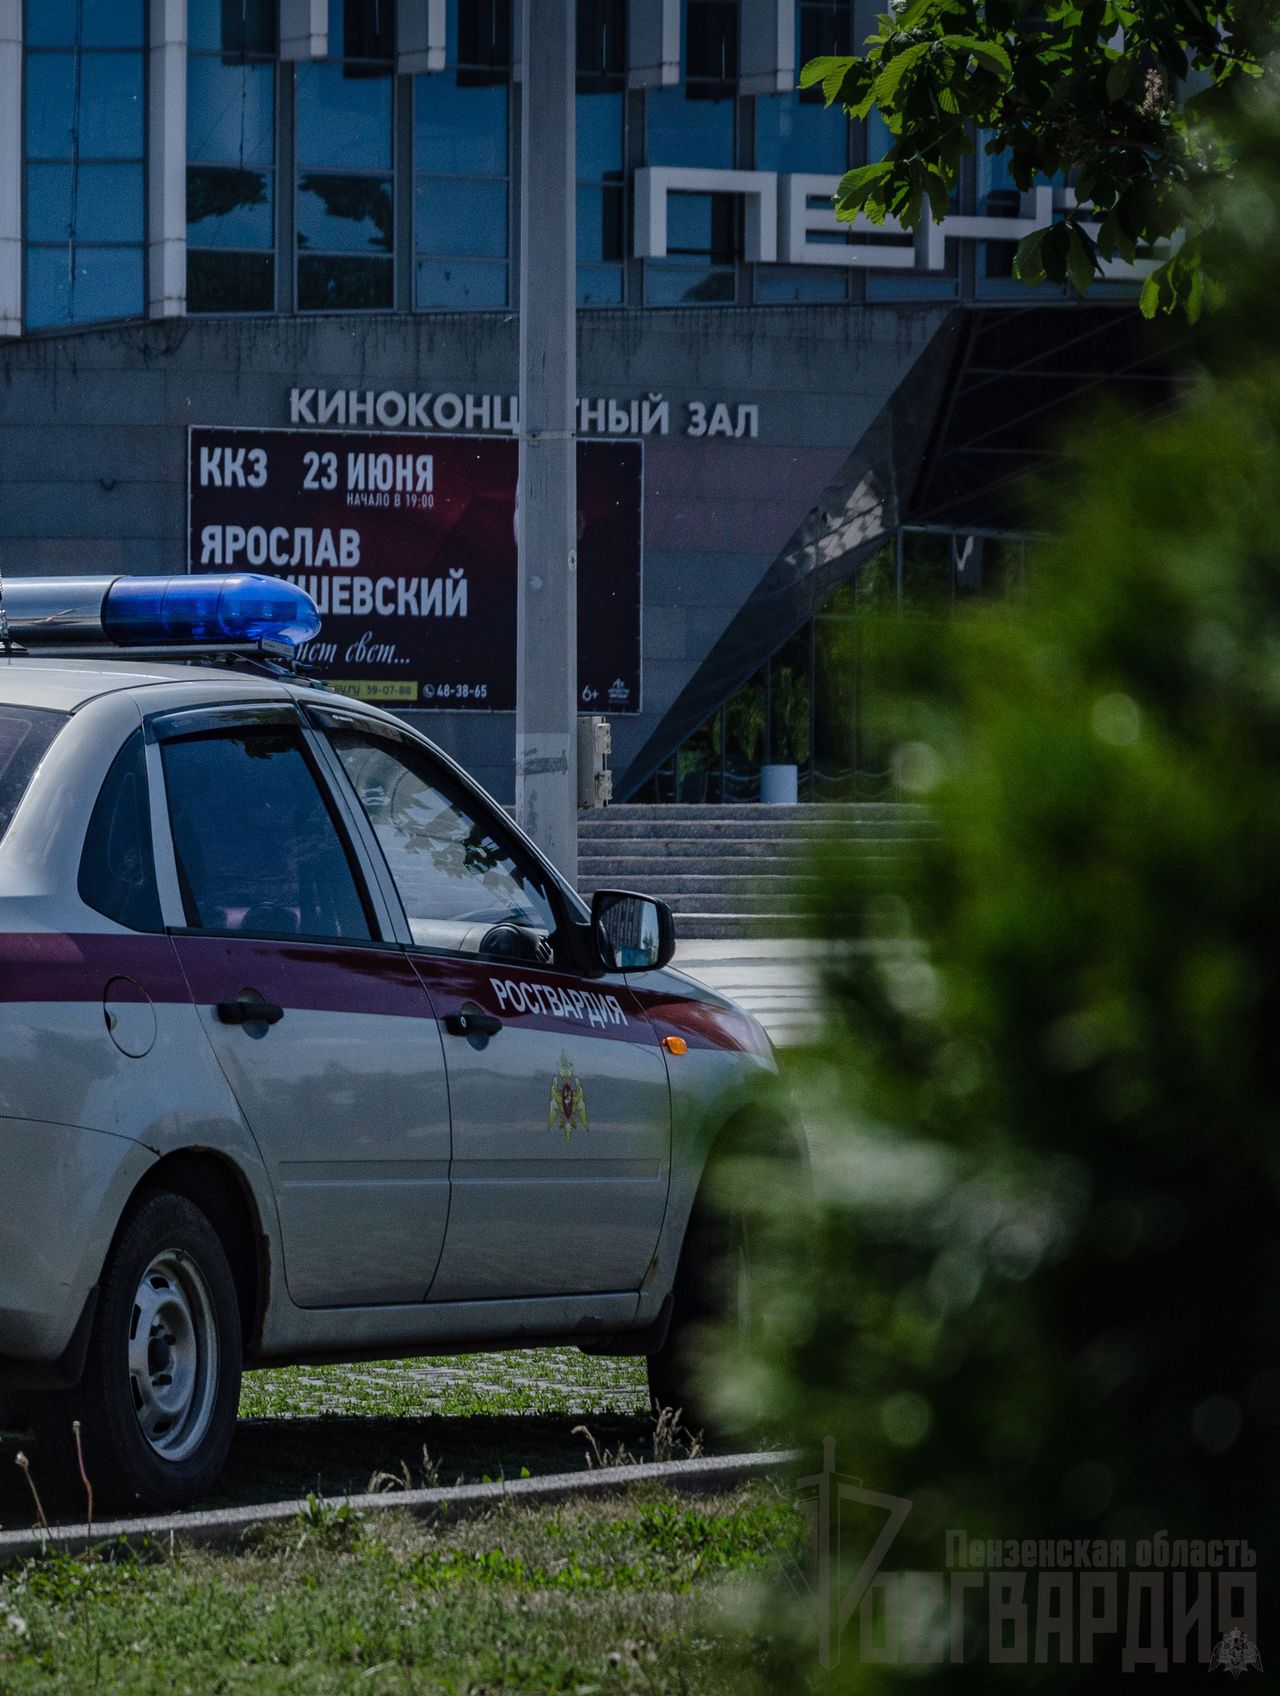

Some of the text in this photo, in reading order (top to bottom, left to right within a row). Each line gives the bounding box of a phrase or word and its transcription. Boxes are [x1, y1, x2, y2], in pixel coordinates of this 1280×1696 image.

[290, 388, 759, 438] КИНОКОНЦНЫЙ ЗАЛ
[200, 446, 268, 487] ККЗ
[303, 451, 434, 494] 23 ИЮНЯ
[346, 492, 434, 509] НАЧАЛО В 19:00
[200, 524, 361, 567] ЯРОСЛАВ
[286, 568, 468, 617] ШЕВСКИЙ
[436, 684, 488, 699] 48-38-65
[582, 684, 599, 702] 6+
[489, 978, 628, 1029] РОСГВАРДИЯ
